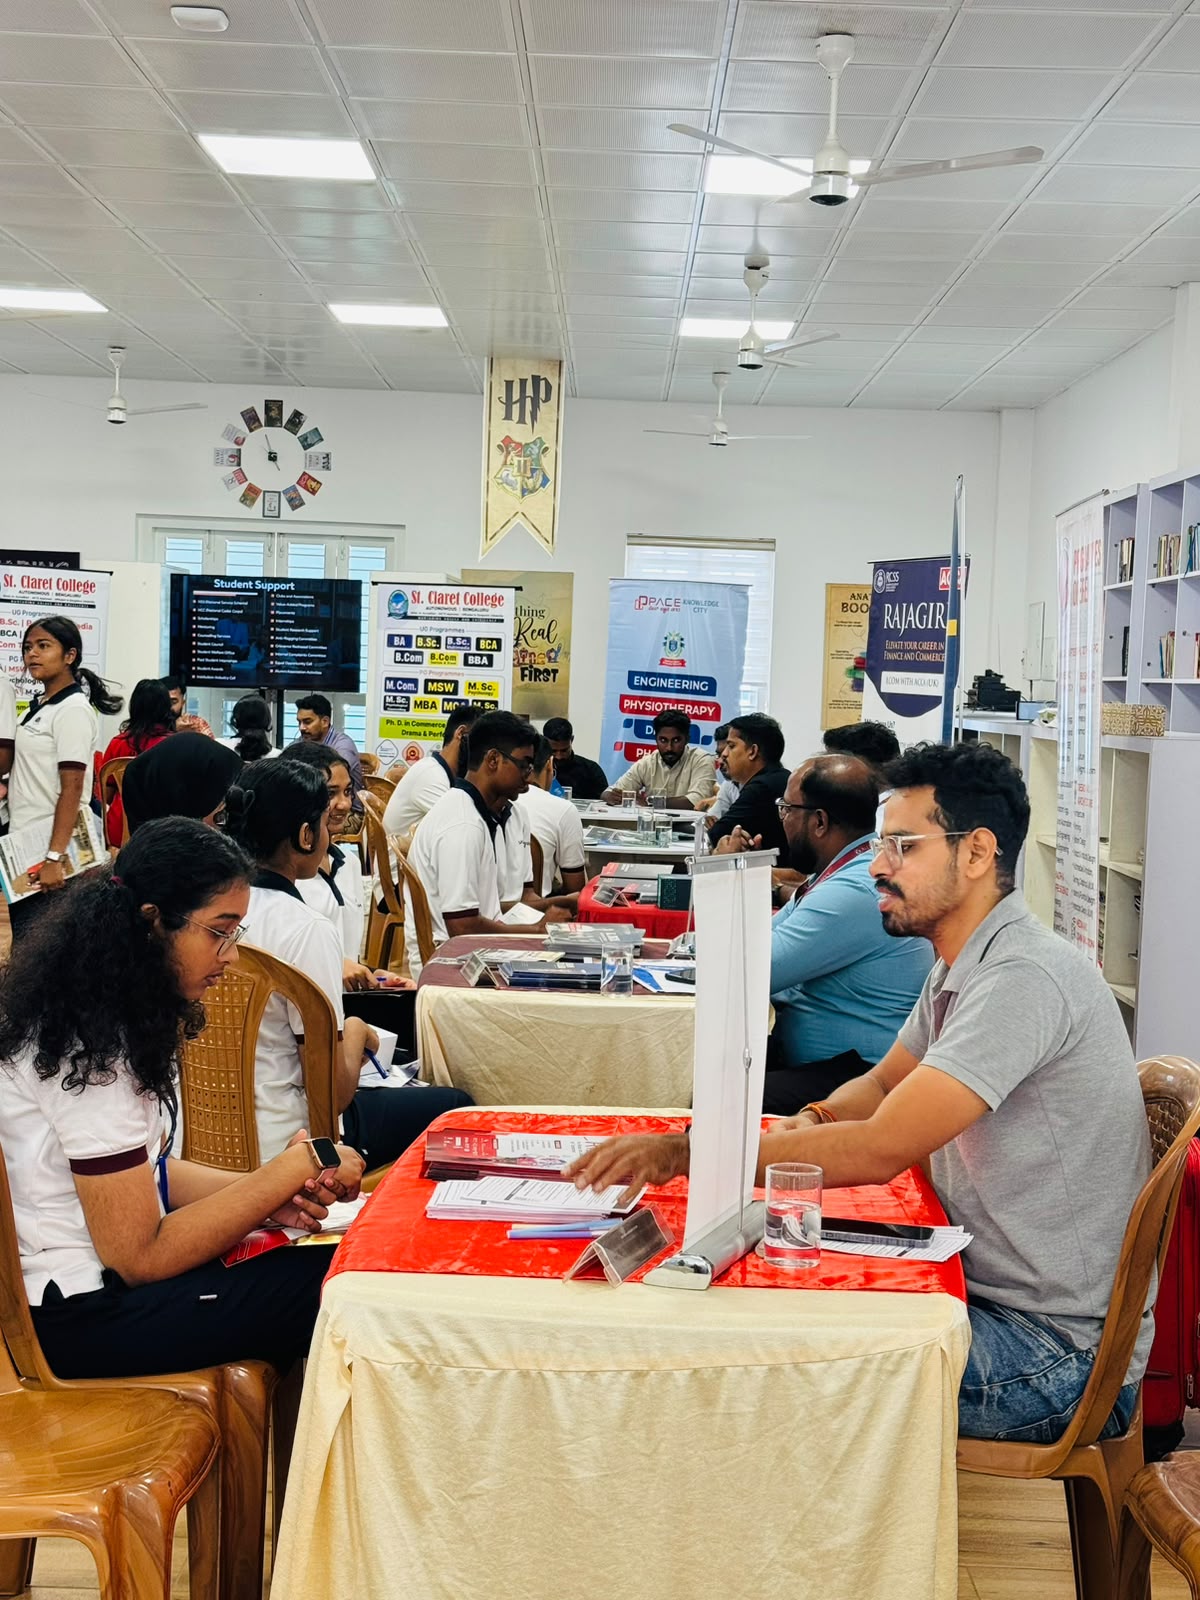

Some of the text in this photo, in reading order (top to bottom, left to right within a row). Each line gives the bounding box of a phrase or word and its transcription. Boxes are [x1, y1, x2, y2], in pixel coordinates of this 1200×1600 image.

[497, 374, 552, 435] HP
[3, 573, 96, 595] St. Claret College
[886, 571, 899, 583] RCSS
[213, 578, 295, 592] Student Support
[411, 590, 505, 608] St. Claret College
[648, 596, 681, 608] PACE
[841, 601, 871, 614] BOO
[883, 602, 948, 637] RAJAGIR
[0, 629, 18, 637] BCA
[393, 636, 498, 650] BA B.Sc. B.Sc. BCA
[395, 652, 423, 662] B.Com
[430, 652, 457, 661] B.Com
[467, 656, 489, 666] BBA
[427, 681, 455, 693] MSW
[633, 675, 709, 692] ENGINEERING
[413, 700, 438, 711] MBA
[623, 699, 716, 717] PHYSIOTHERAPY
[404, 719, 410, 727] in
[411, 720, 446, 728] Commerce
[401, 729, 422, 737] Drama
